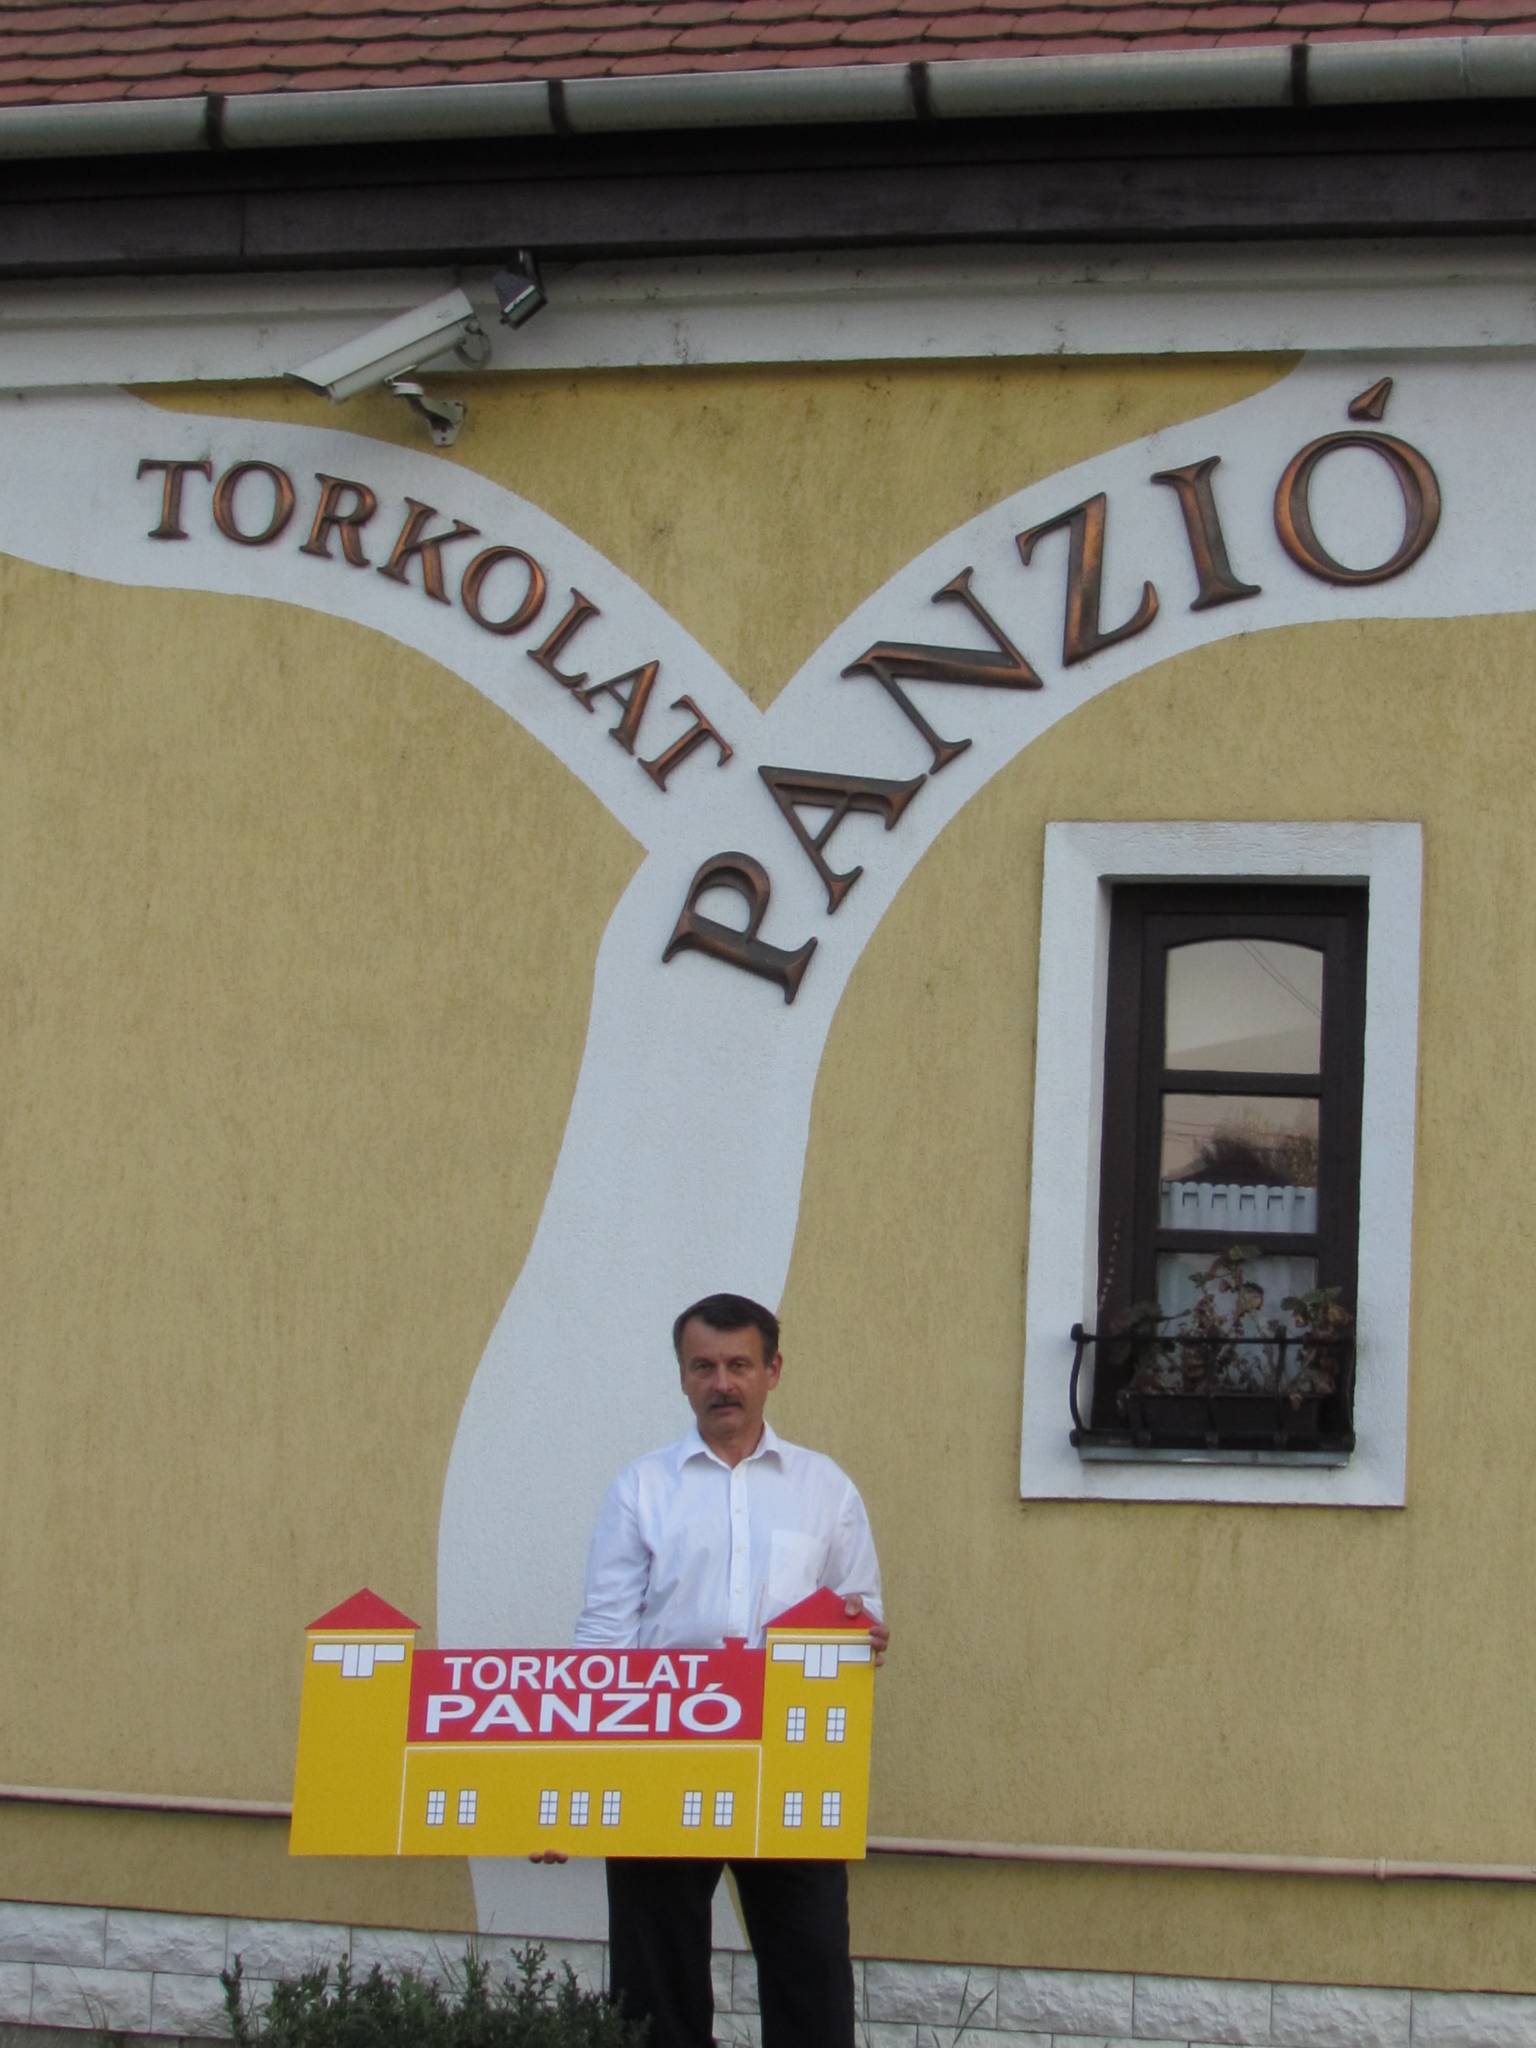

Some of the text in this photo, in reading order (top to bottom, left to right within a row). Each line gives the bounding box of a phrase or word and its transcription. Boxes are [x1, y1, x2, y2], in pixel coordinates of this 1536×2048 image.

[136, 458, 734, 793] TORKOLAT
[661, 376, 1442, 1006] PANZIÓ
[425, 1683, 742, 1734] PANZIÓ
[443, 1655, 709, 1690] TORKOLAT
